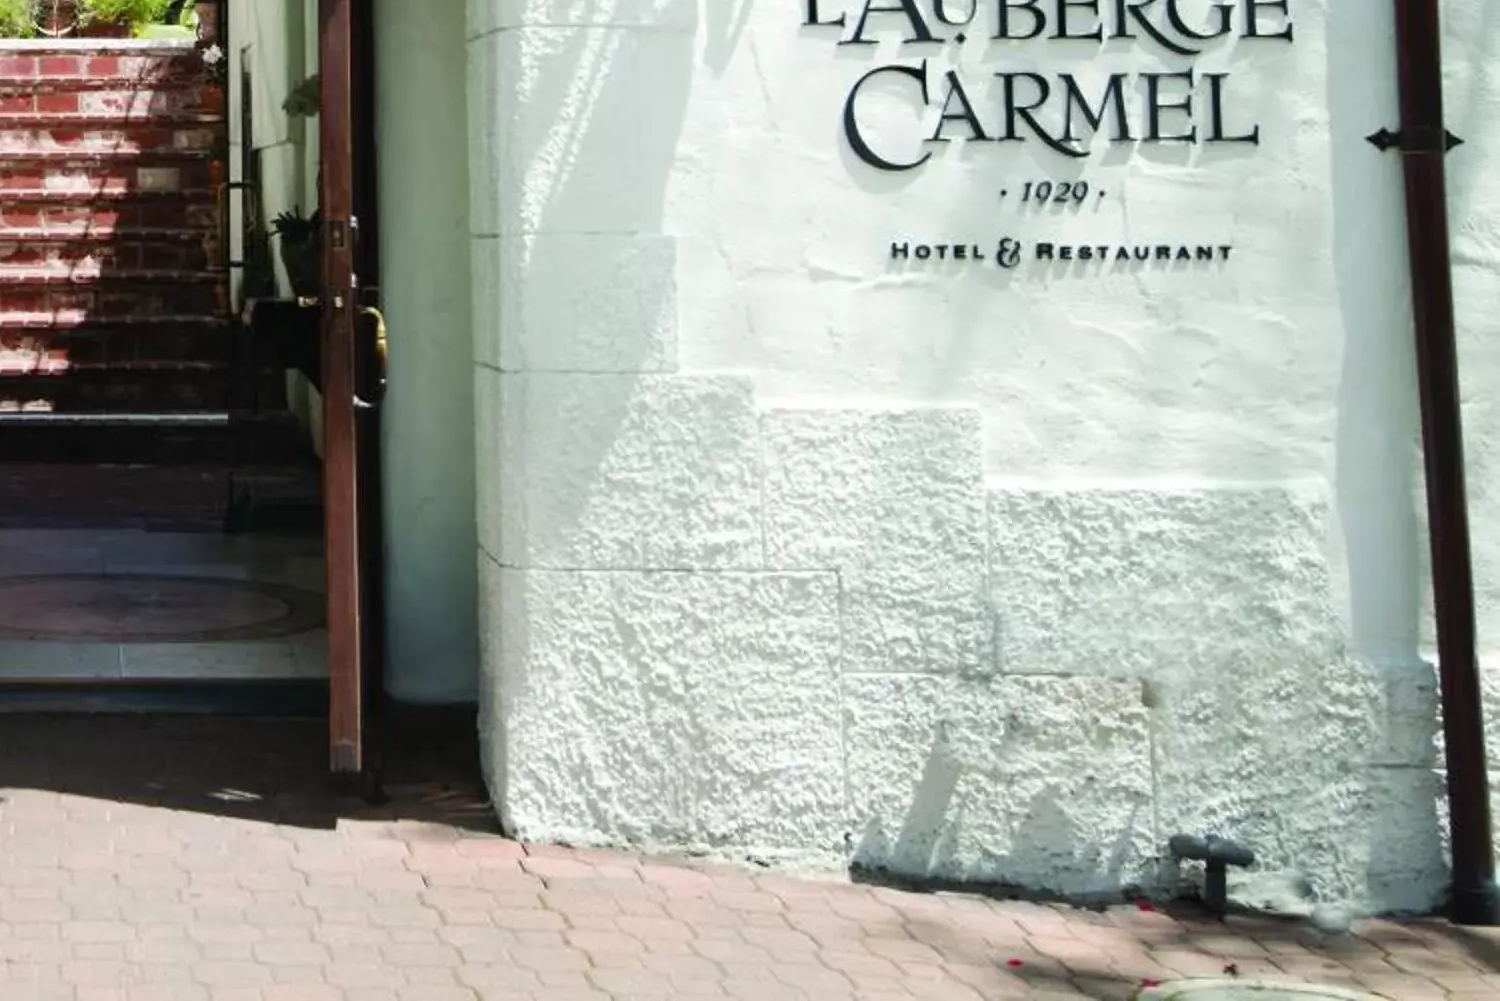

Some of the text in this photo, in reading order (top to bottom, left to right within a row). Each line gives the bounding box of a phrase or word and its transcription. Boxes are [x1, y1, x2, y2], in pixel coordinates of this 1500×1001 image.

[844, 59, 1260, 171] CARMEL
[891, 238, 1233, 268] HOTEL & RESTAURANT
